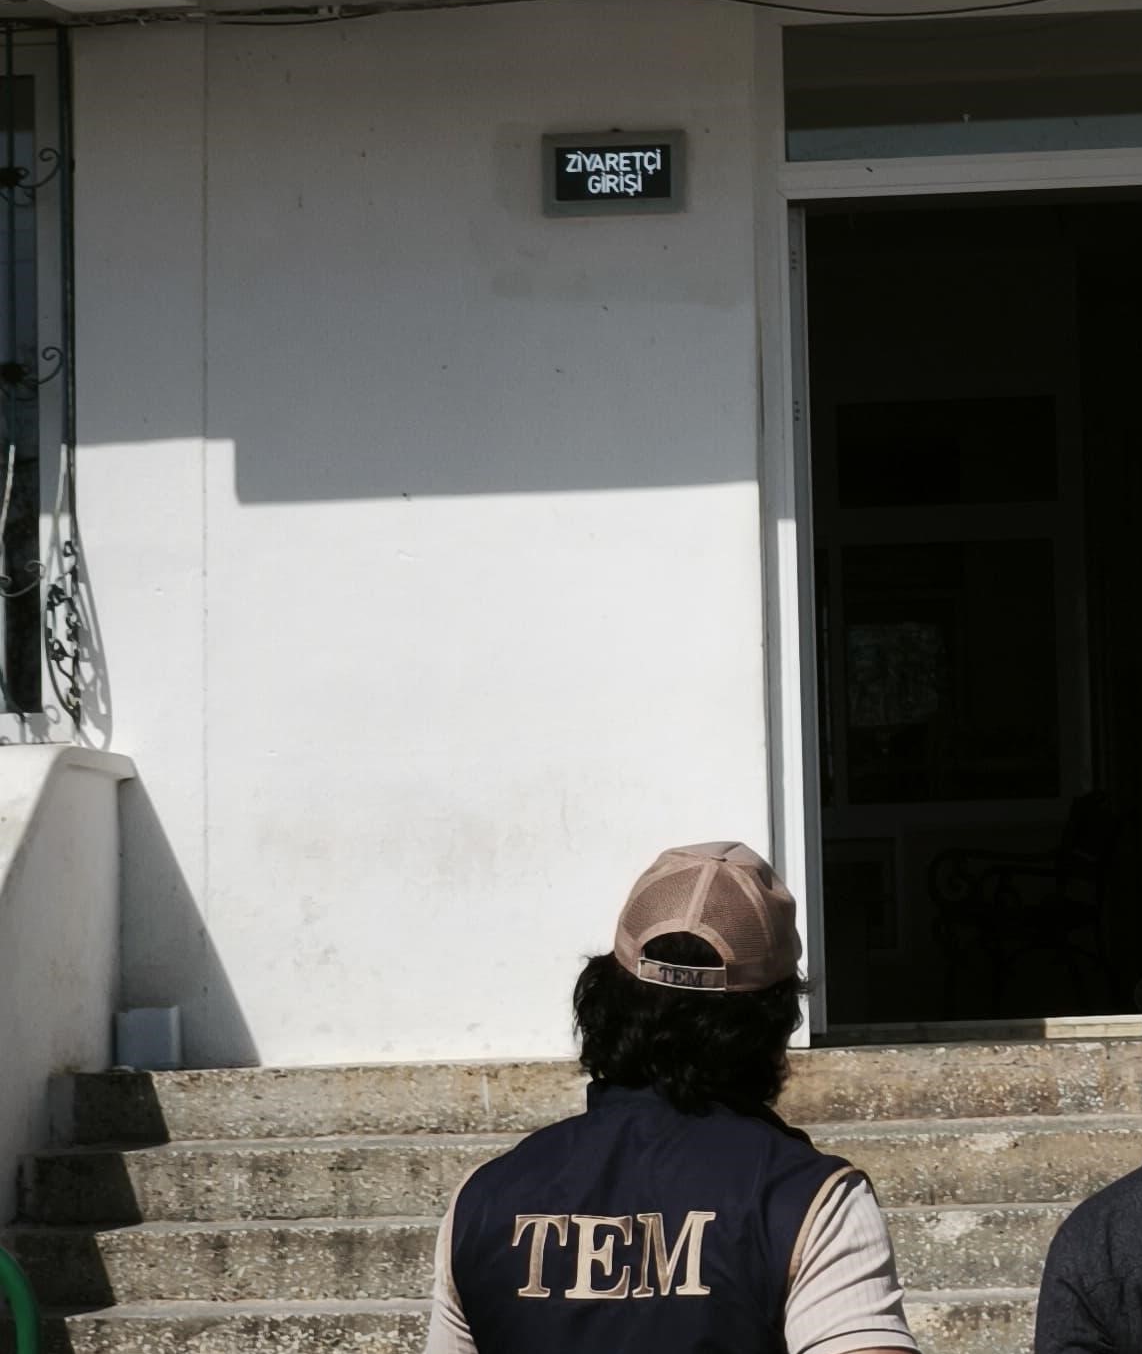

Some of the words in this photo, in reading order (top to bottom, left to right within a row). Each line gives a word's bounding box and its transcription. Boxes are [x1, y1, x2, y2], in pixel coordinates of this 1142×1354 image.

[565, 148, 662, 175] ZİYARETÇİ
[587, 171, 643, 196] GİRİŞİ
[658, 965, 704, 987] TEM
[511, 1210, 717, 1300] TEM
